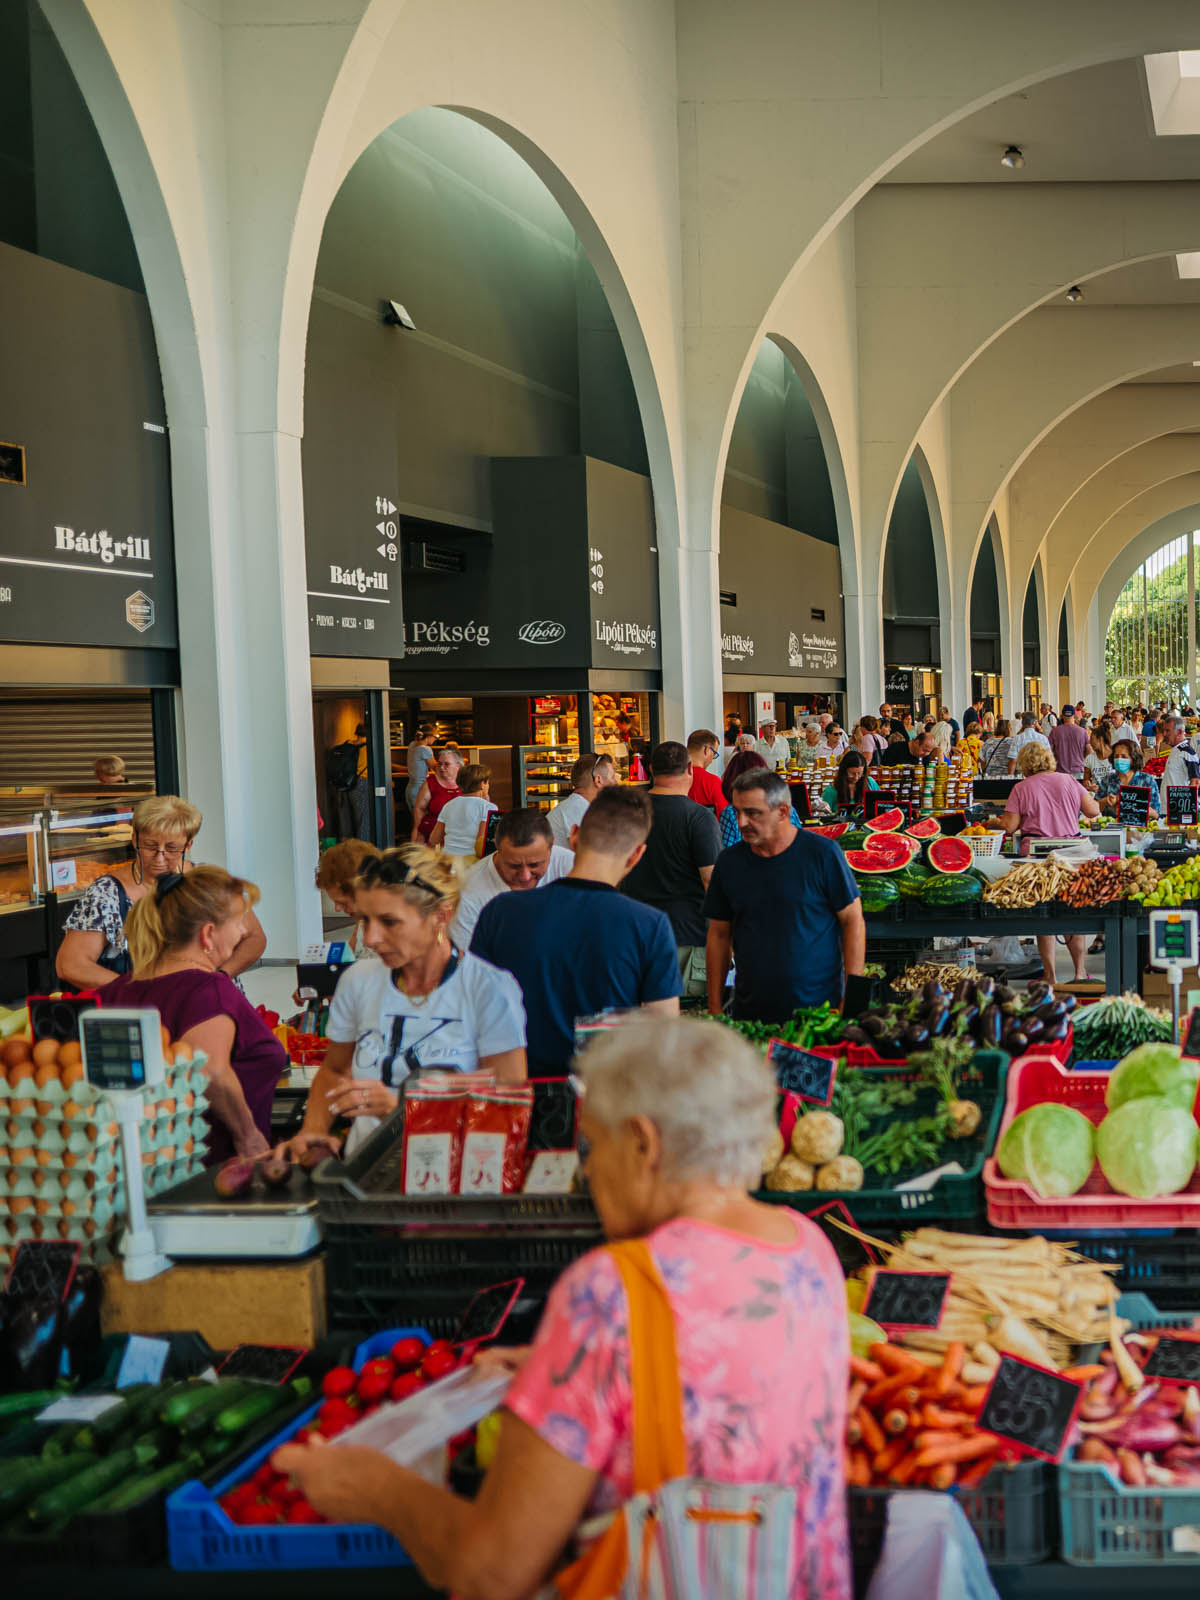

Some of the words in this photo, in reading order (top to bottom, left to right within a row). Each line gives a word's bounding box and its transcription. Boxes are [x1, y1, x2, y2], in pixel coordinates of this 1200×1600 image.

[54, 526, 151, 563] Bátgrill
[330, 565, 389, 593] Bátgrill
[413, 620, 490, 646] Pékség
[520, 621, 563, 641] Lipóti
[596, 620, 625, 645] Lipóti
[625, 623, 657, 648] Pékség
[405, 644, 450, 655] agyomány
[732, 635, 754, 656] Pékség
